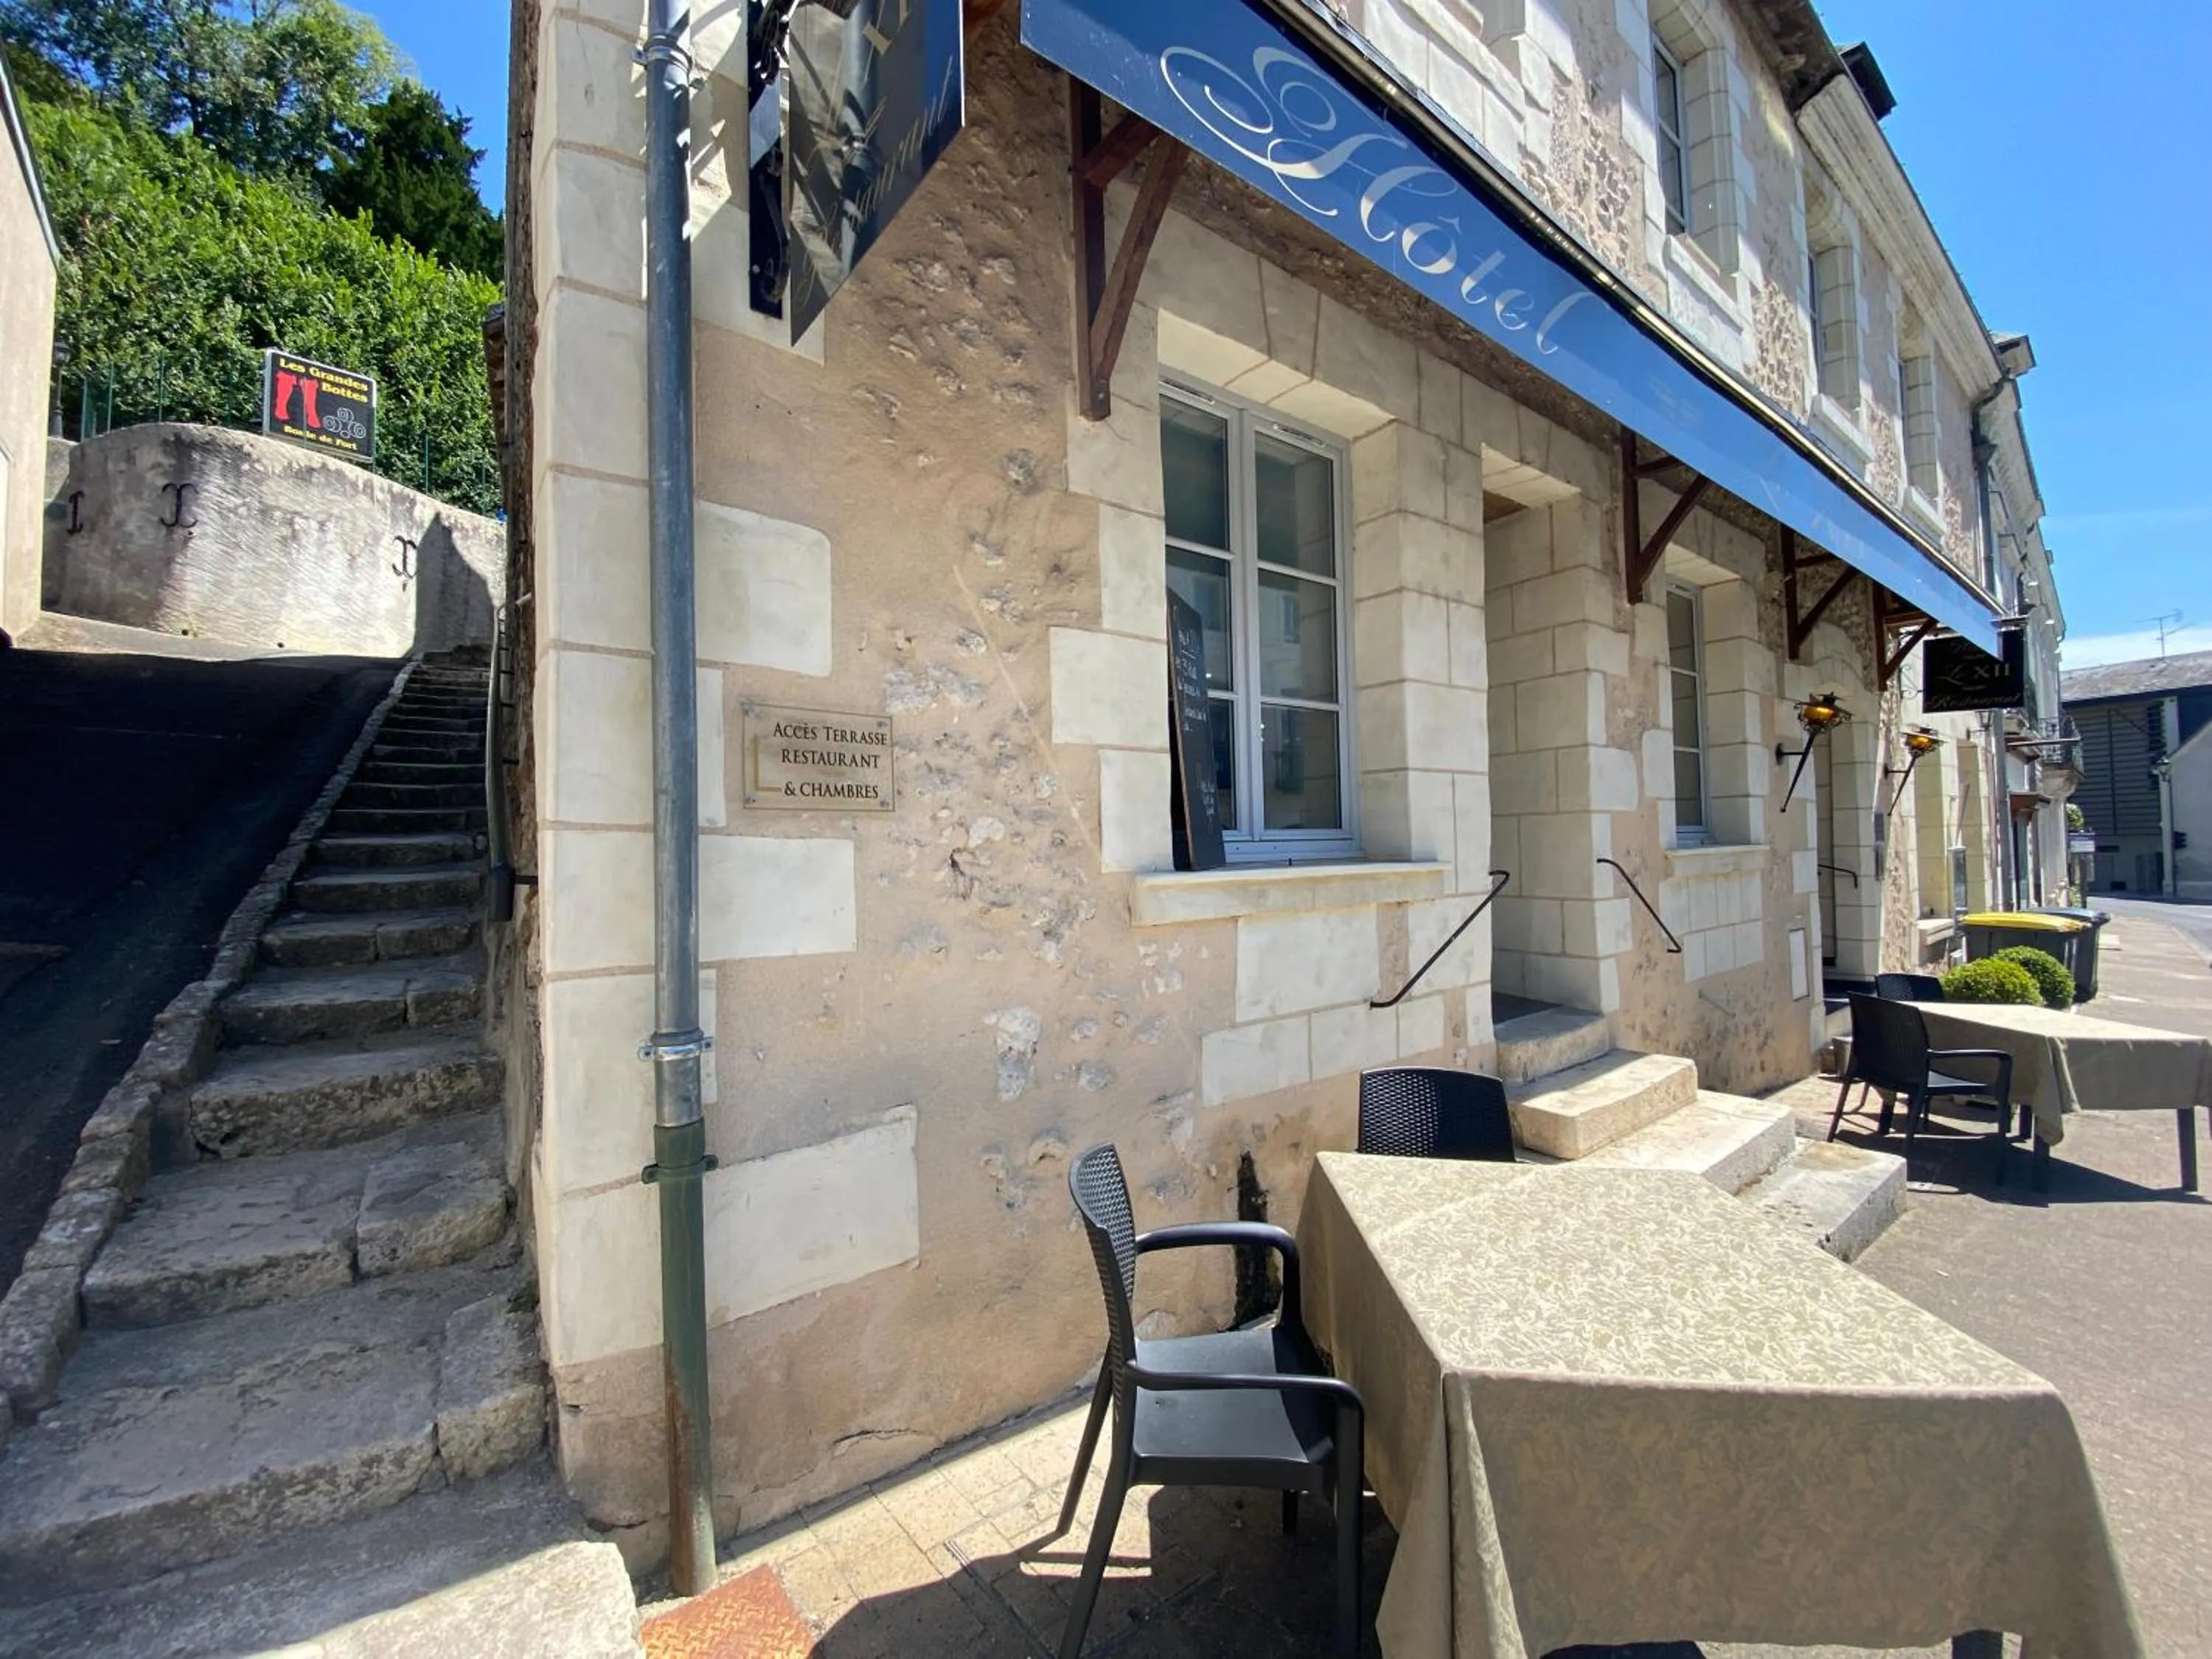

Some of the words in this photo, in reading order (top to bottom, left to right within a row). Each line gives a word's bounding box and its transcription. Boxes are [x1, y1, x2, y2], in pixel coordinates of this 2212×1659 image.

[279, 357, 306, 373] Les
[310, 367, 368, 392] Grandes
[321, 382, 368, 403] Bottes
[319, 434, 333, 444] de
[335, 438, 358, 451] Fort
[823, 726, 888, 745] TERRASSE
[780, 748, 881, 768] RESTAURANT
[784, 782, 796, 797] &
[799, 782, 879, 799] CHAMBRES
